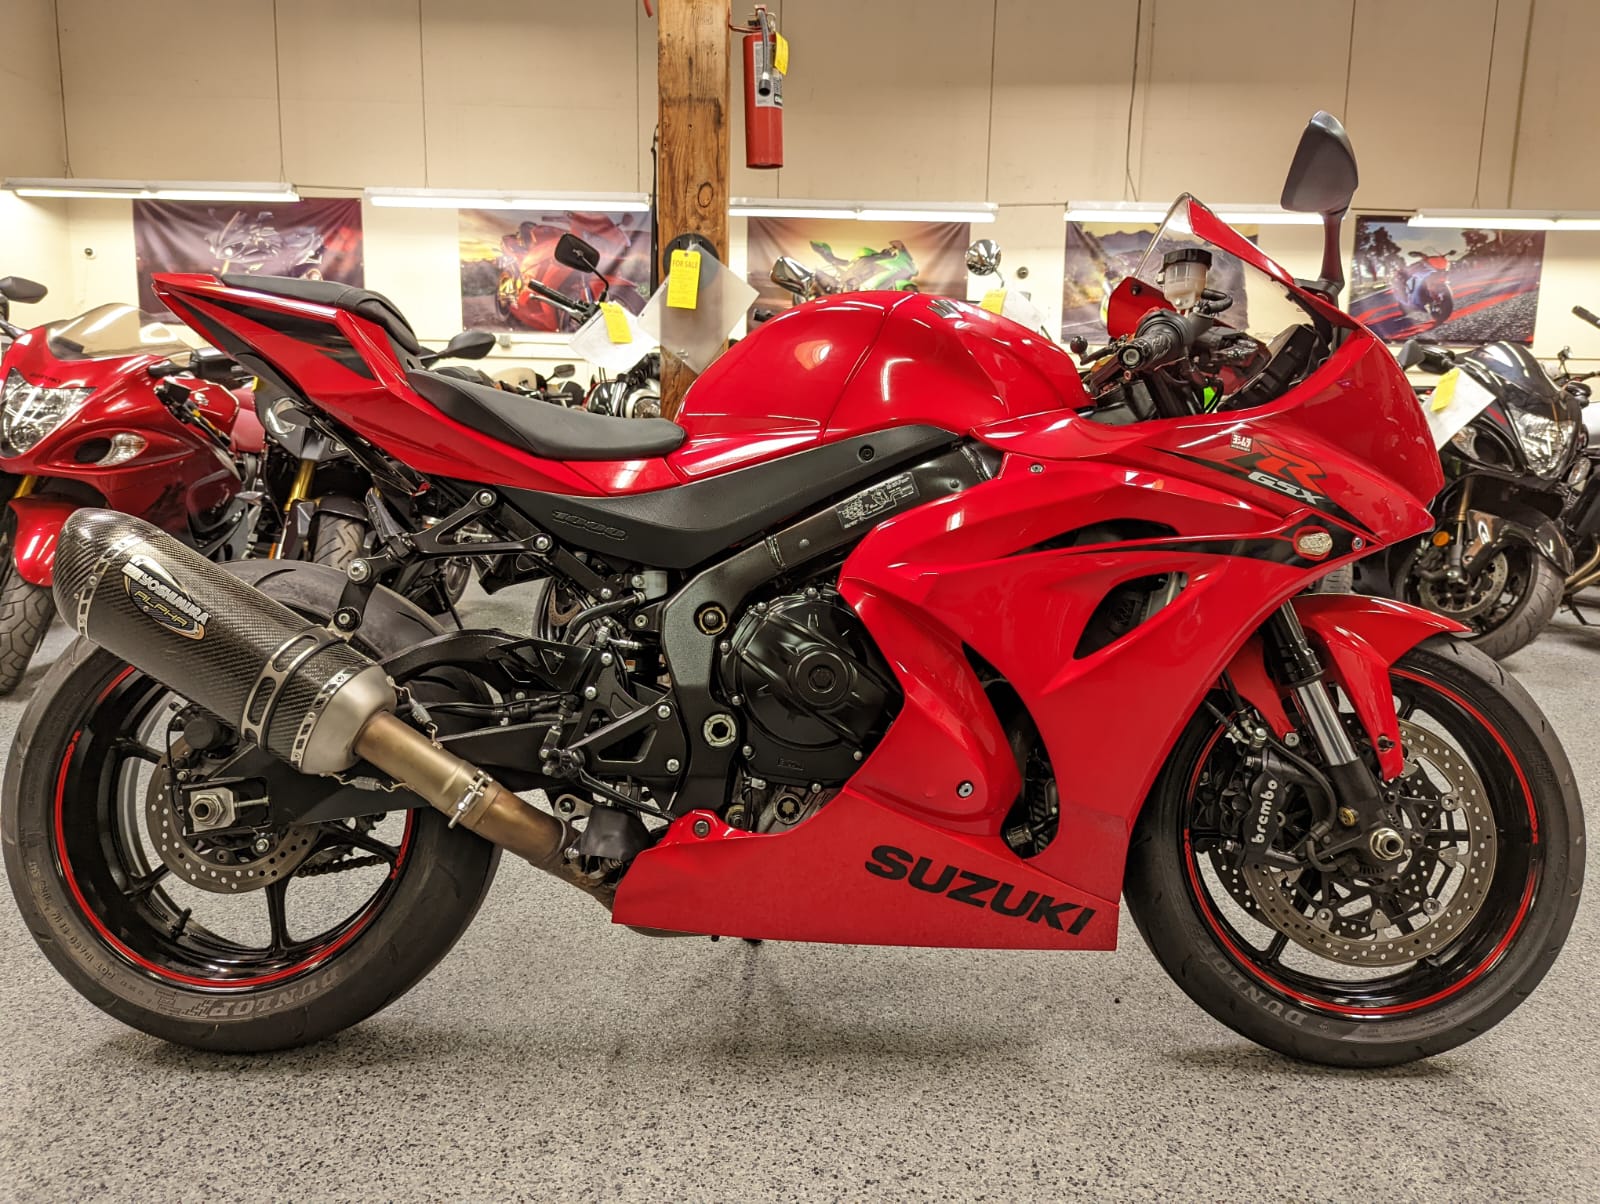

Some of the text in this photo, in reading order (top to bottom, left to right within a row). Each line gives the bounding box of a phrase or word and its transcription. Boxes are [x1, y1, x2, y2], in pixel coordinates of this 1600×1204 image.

[672, 259, 684, 268] FOR
[1248, 471, 1325, 505] GSX
[134, 590, 188, 627] ALPHA
[139, 572, 209, 626] YOSHIMURA
[1251, 779, 1278, 844] brembo
[865, 844, 1097, 936] SUZUKI
[208, 965, 340, 1018] DUNLOP
